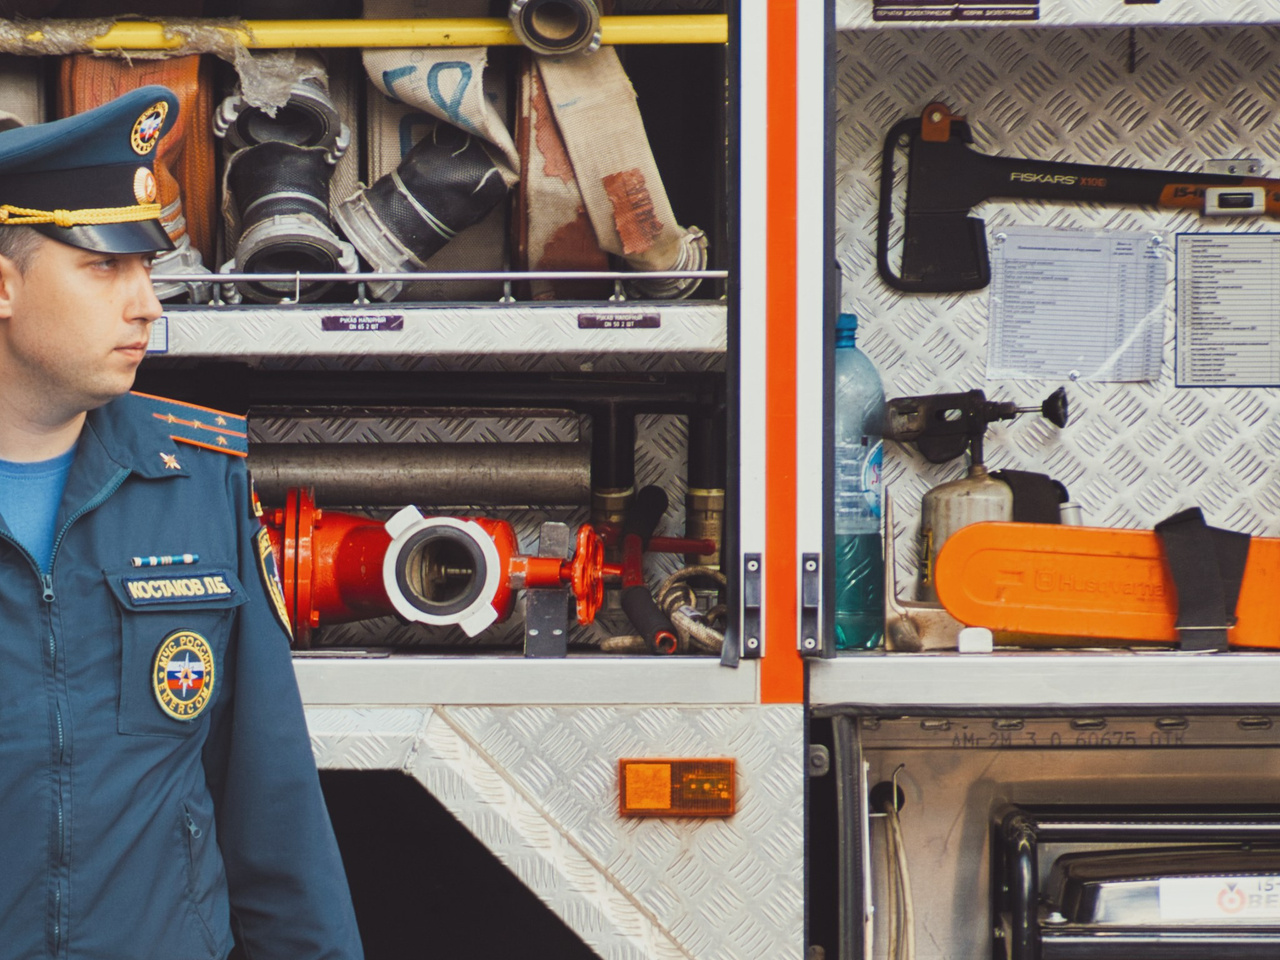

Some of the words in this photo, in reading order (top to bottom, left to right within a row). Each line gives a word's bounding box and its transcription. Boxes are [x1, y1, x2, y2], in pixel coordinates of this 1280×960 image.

[1011, 172, 1075, 185] FISKARS
[127, 578, 205, 598] КОСТАКОВ
[1059, 574, 1164, 598] Husqvarna
[158, 641, 177, 668] МЧС
[180, 636, 211, 672] РОССИИ
[158, 683, 209, 714] EMERCOM
